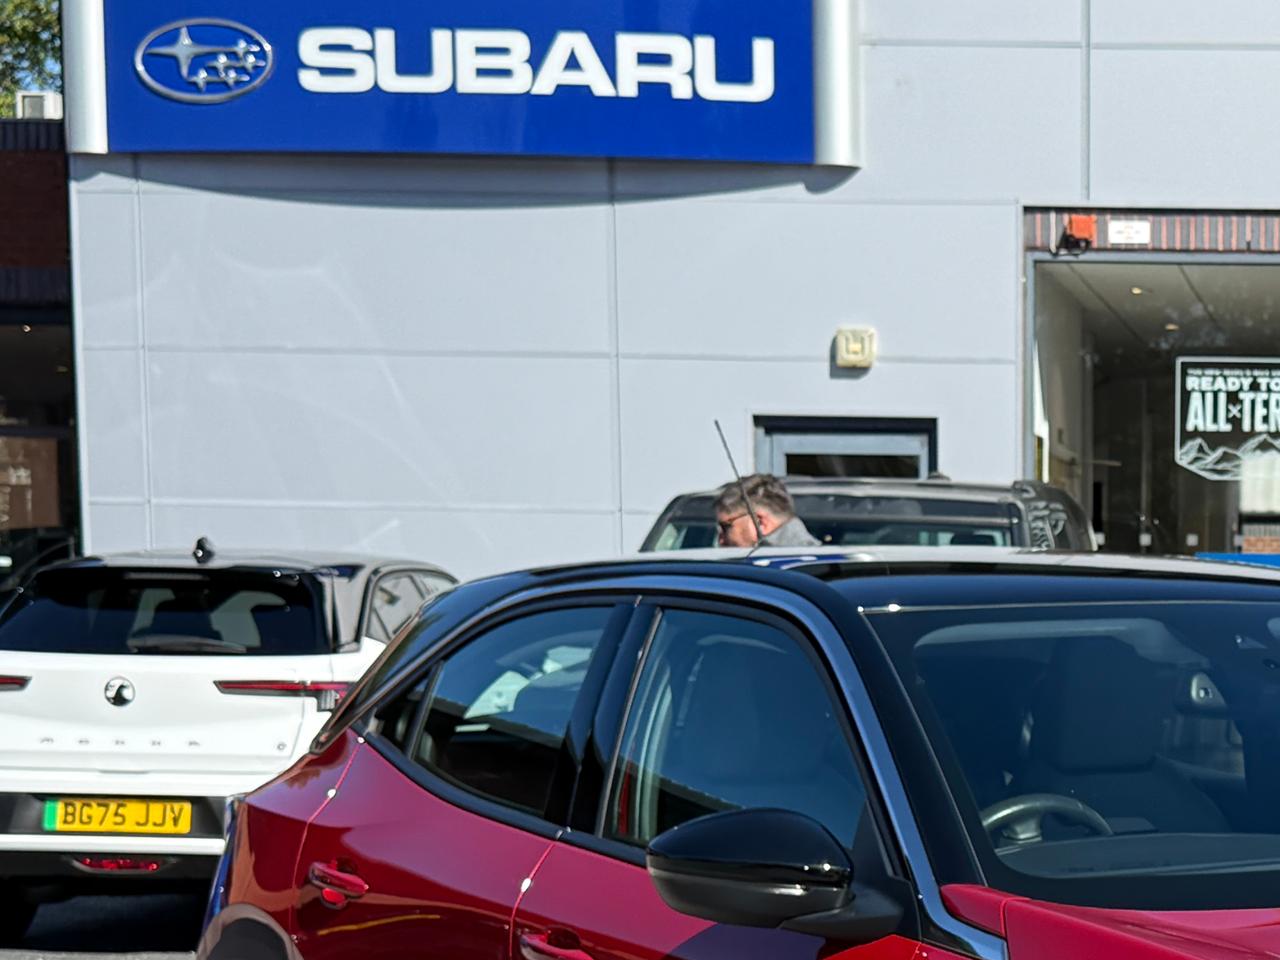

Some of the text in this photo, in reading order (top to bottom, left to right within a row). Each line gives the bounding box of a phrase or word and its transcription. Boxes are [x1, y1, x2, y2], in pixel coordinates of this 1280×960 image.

[297, 26, 775, 102] SUBARU
[1185, 376, 1252, 392] READY
[62, 801, 185, 828] BG75 JJV
